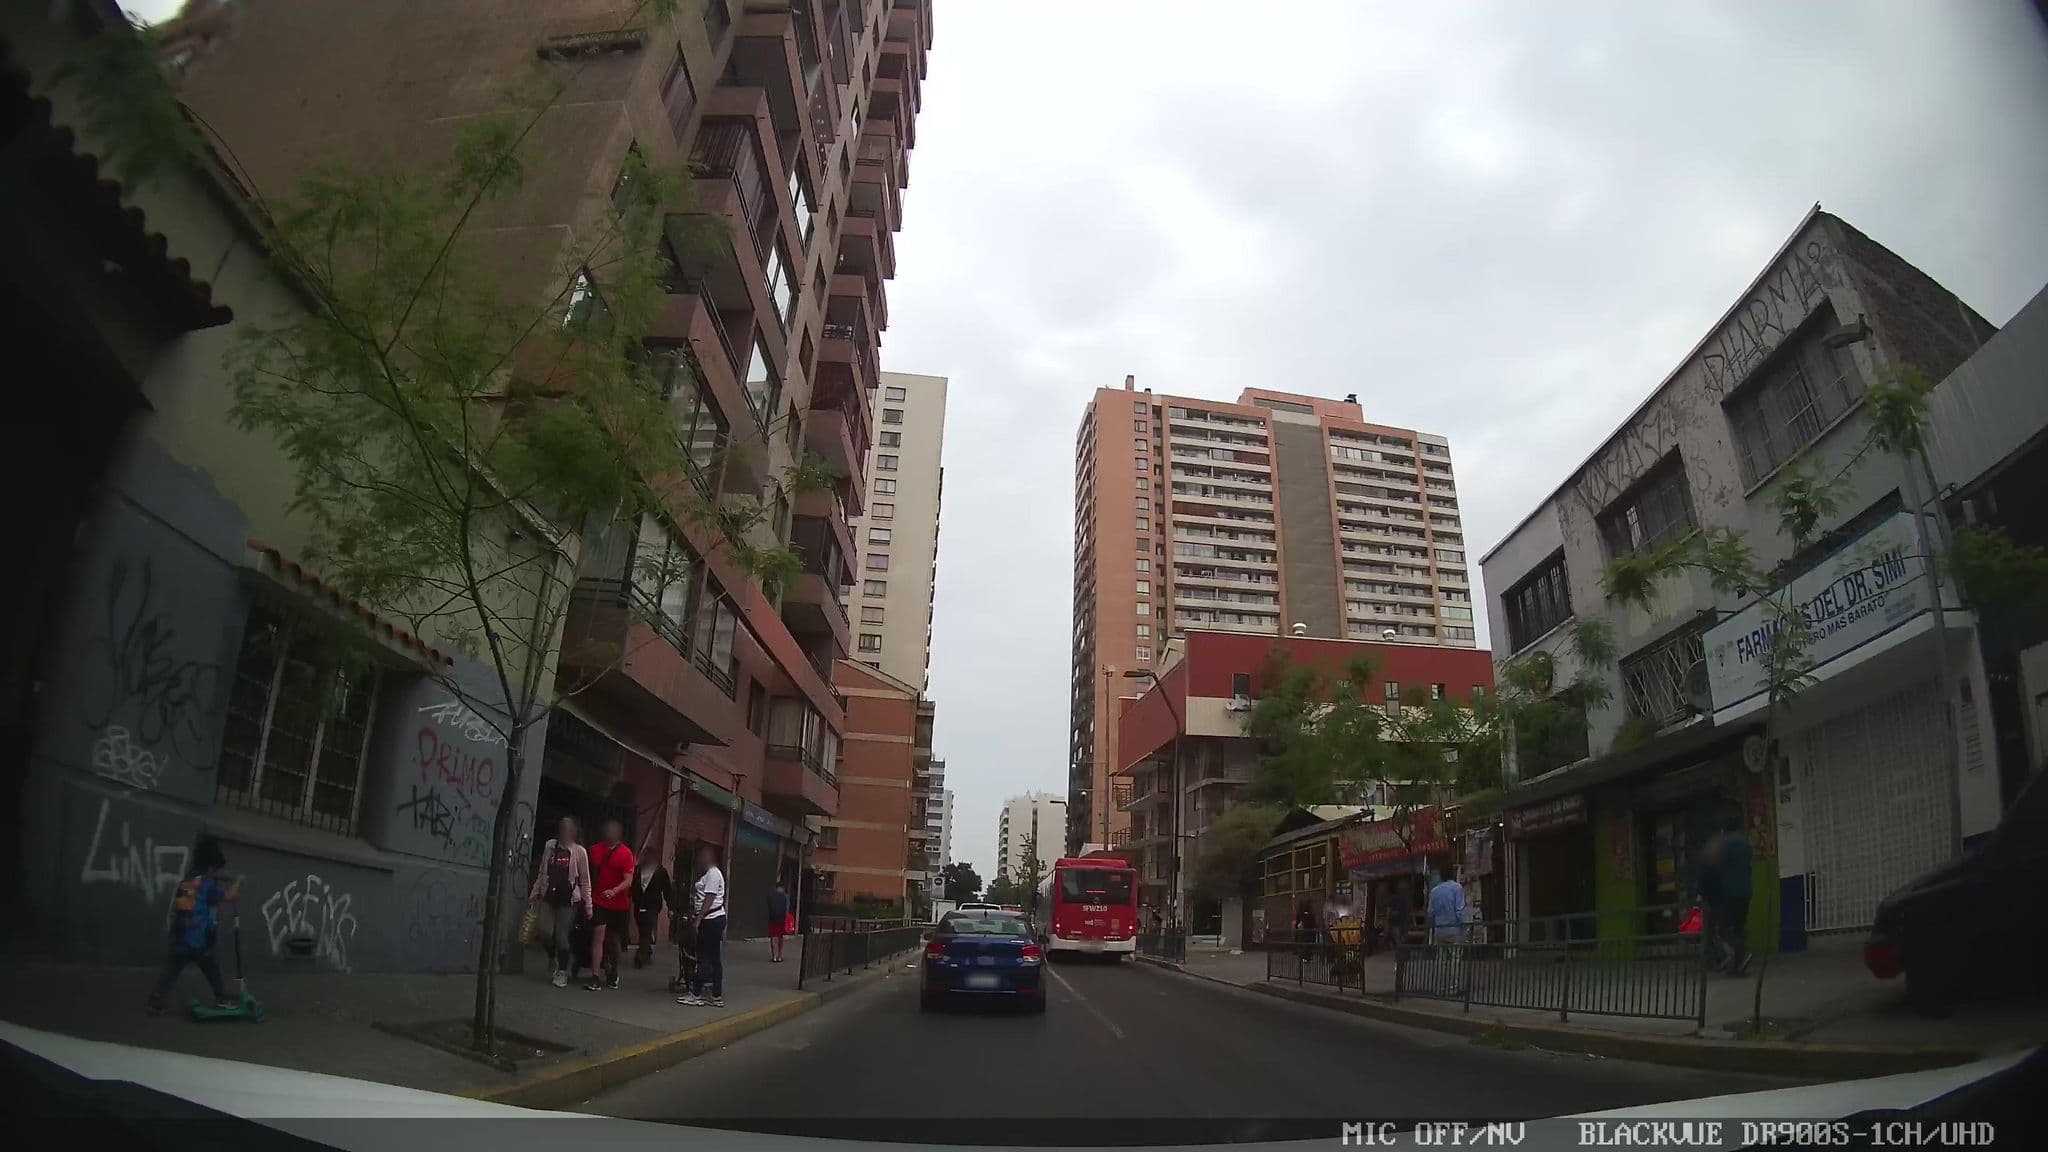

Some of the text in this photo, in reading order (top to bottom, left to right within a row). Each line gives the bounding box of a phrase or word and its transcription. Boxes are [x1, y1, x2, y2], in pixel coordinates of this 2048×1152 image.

[1737, 602, 1813, 664] FARMACAS
[1814, 585, 1844, 622] DEL
[1844, 571, 1873, 607] DR.
[1872, 551, 1907, 591] SIMI
[1826, 616, 1847, 638] MAS
[1848, 596, 1885, 624] BARATO
